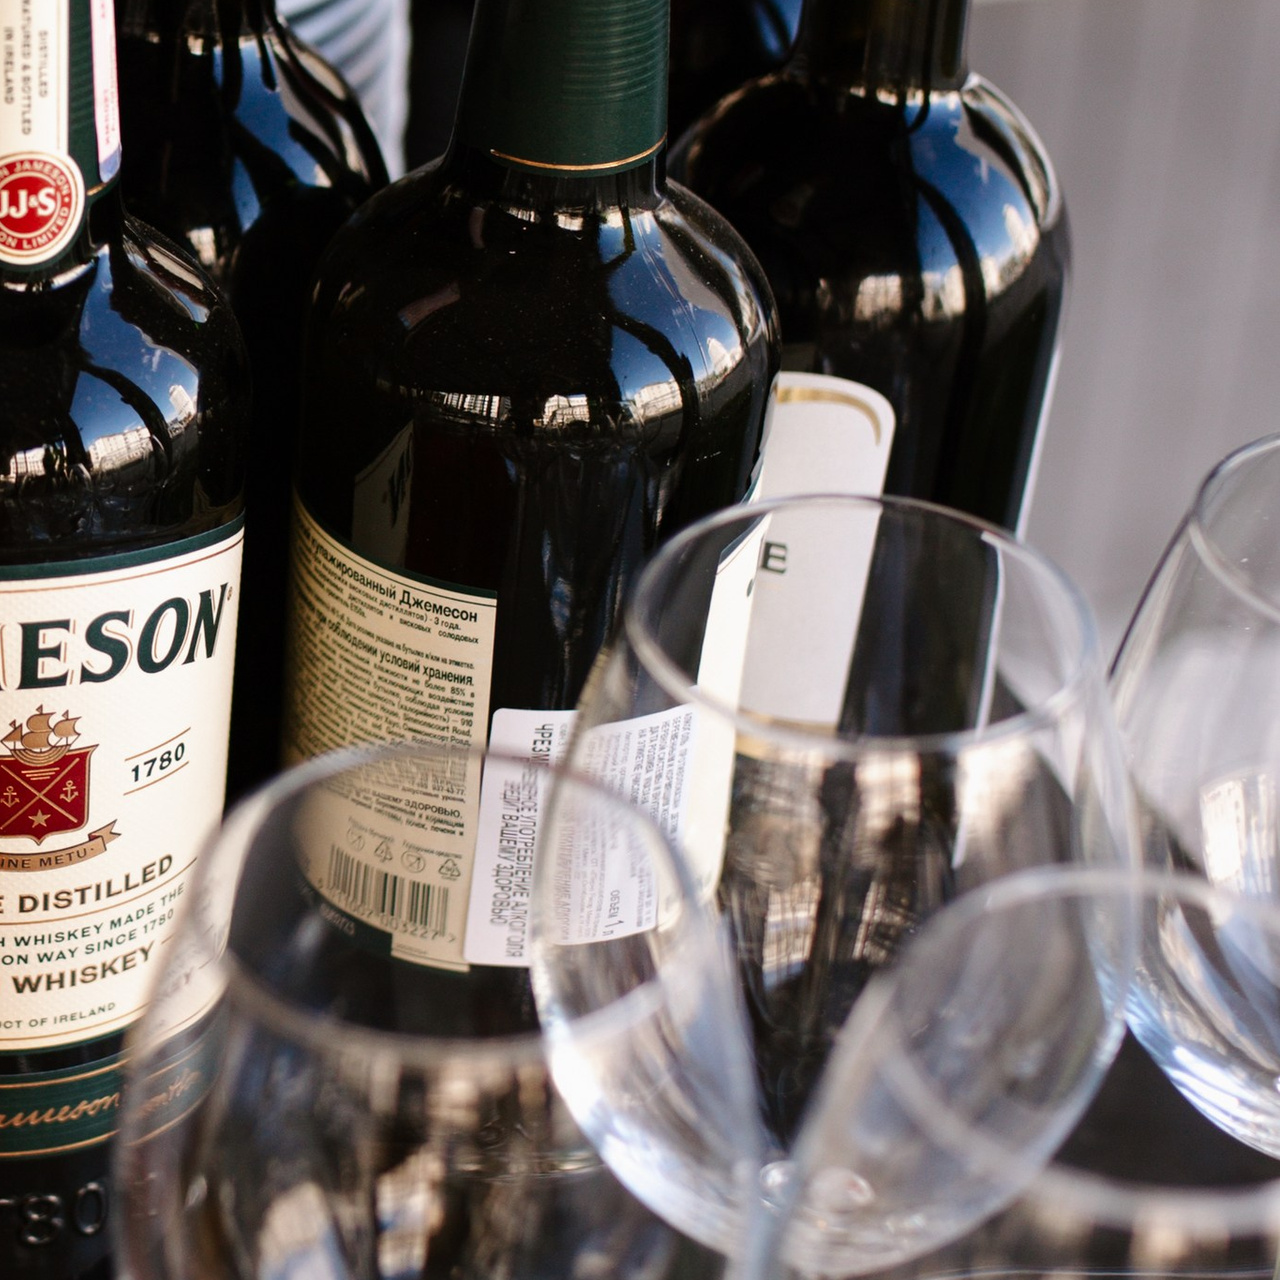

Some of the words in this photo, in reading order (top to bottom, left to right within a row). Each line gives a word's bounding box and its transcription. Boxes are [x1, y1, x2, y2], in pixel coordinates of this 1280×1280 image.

[4, 26, 14, 41] IN
[4, 44, 15, 105] IRELAND
[38, 30, 49, 98] DISTILLED
[21, 75, 32, 136] BOTTLED
[14, 161, 71, 196] JAMESON
[22, 207, 70, 249] LIMITED
[399, 589, 478, 623] Джемесон
[434, 617, 439, 625] 3
[441, 619, 461, 630] года.
[399, 618, 431, 633] висковых
[438, 630, 479, 644] солодовых
[379, 651, 420, 674] условий
[422, 663, 474, 686] хранения.
[424, 678, 446, 693] более
[450, 686, 465, 697] 85%
[428, 692, 474, 708] воздействие
[444, 704, 474, 717] условия
[451, 726, 473, 738] Road,
[638, 728, 647, 738] НА
[649, 725, 659, 742] ДАТА
[131, 742, 187, 783] 1780
[405, 799, 463, 819] ЗДОРОВЬЮ.
[497, 814, 519, 862] ВАШЕМУ
[38, 846, 88, 869] METU
[512, 815, 537, 898] УПОТРЕБЛЕНИЕ
[17, 852, 175, 914] DISTILLED
[490, 863, 514, 924] ЗДОРОВЬЮ
[13, 922, 104, 948] WHISKEY
[108, 902, 156, 931] MADE
[160, 881, 187, 908] THE
[506, 901, 528, 958] АЛКОГОЛЯ
[604, 920, 624, 928] 1
[35, 946, 79, 965] WAY
[83, 929, 138, 956] SINCE
[142, 907, 175, 935] 1780
[11, 939, 157, 995] WHISKEY
[28, 1016, 49, 1029] OF
[53, 1001, 117, 1025] IRELAND
